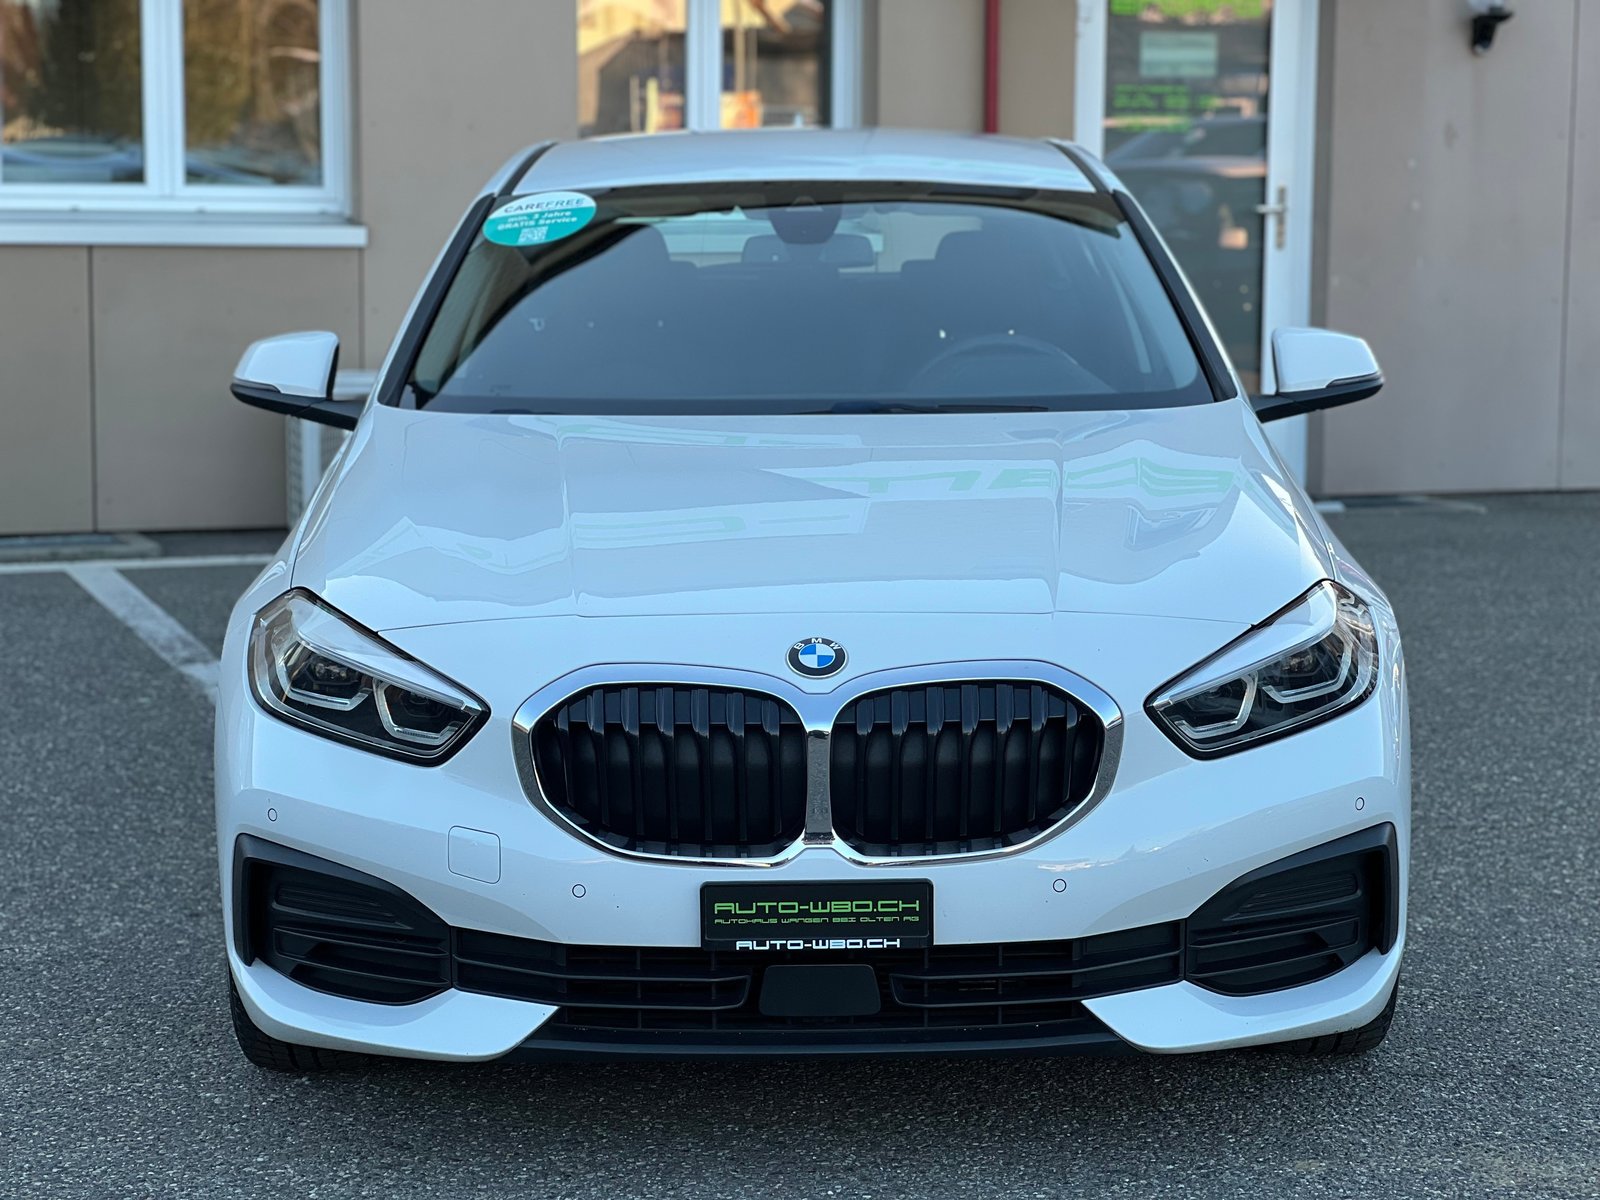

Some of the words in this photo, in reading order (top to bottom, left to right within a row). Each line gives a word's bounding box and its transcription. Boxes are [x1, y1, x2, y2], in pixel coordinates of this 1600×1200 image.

[504, 198, 584, 213] CAREFREE
[542, 210, 572, 219] Jahre
[497, 220, 536, 231] GRATIS
[538, 217, 577, 225] Service
[794, 638, 841, 650] BMW
[714, 900, 920, 915] AUTO-WBO.CH
[736, 938, 901, 951] AUTO-WBO.CH
